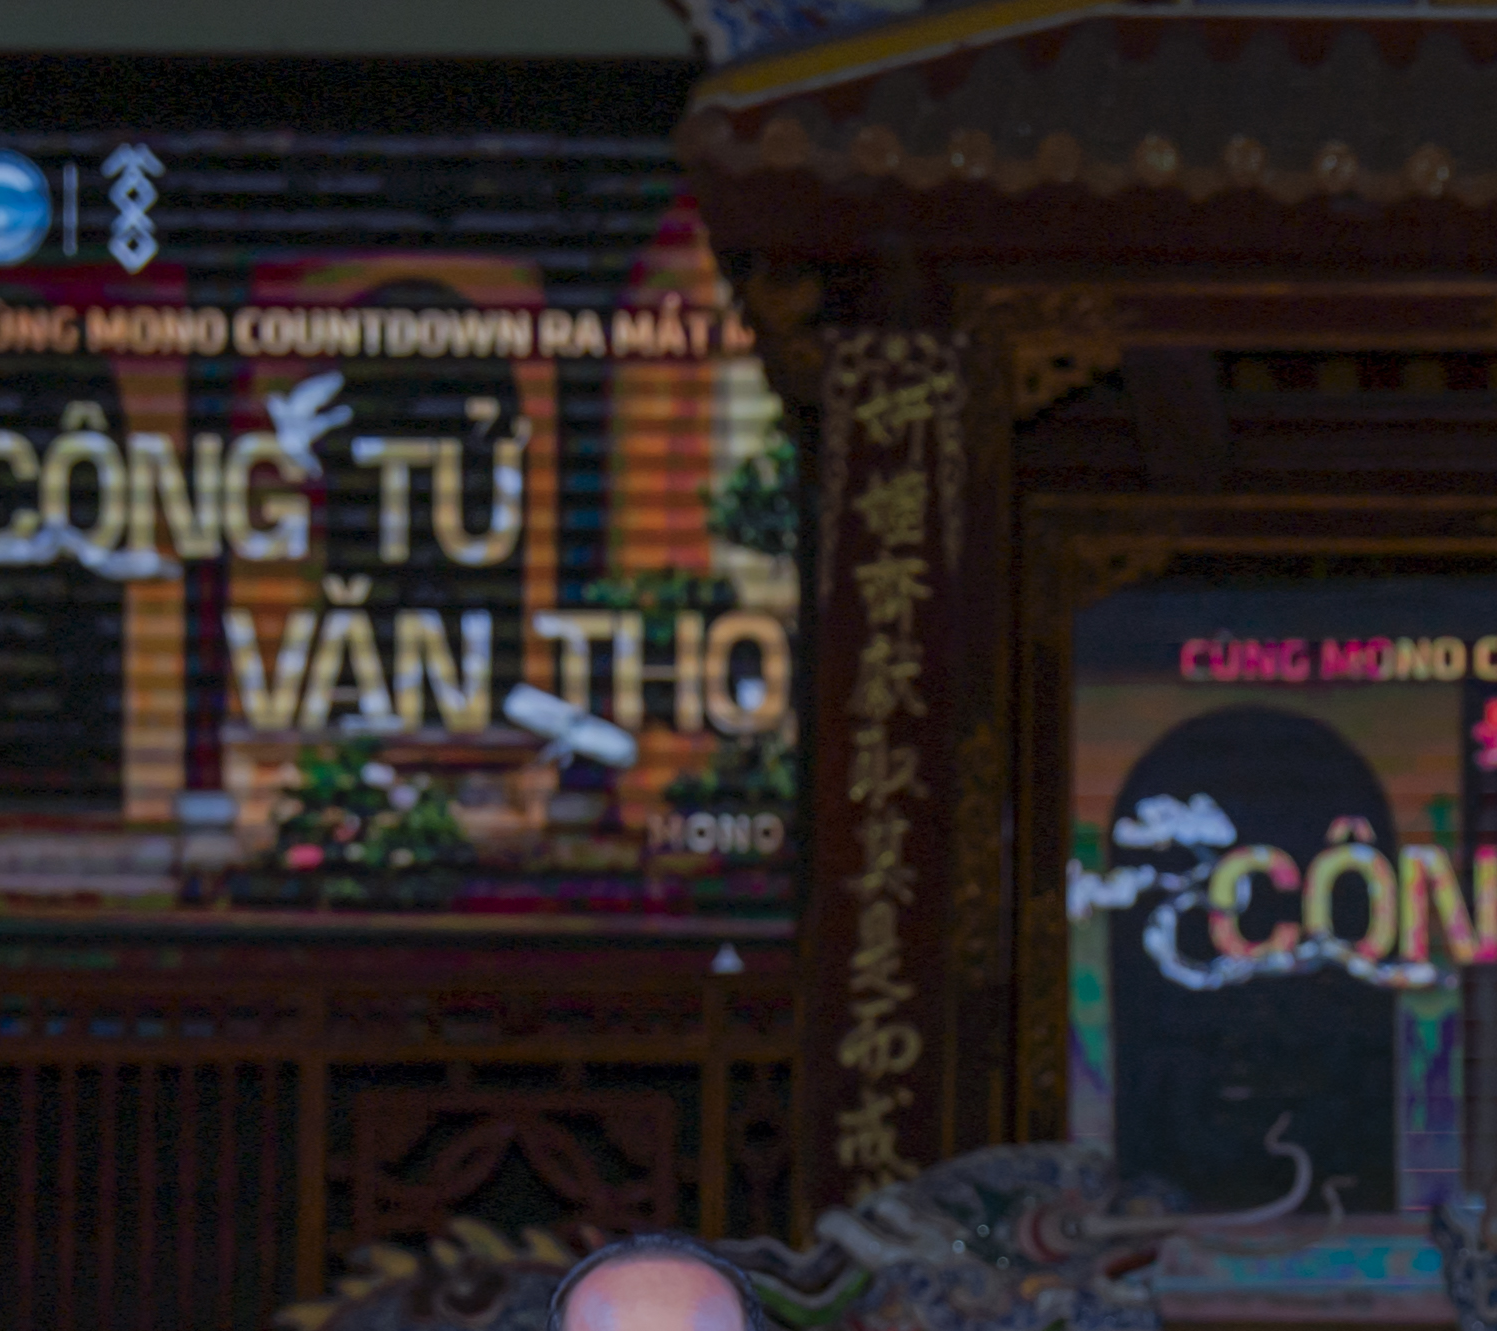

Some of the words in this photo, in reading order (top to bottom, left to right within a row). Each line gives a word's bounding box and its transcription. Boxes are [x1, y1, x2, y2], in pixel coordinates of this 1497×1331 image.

[85, 304, 229, 356] MONO
[232, 306, 536, 357] COUNTDOWN
[538, 307, 607, 358] RA
[352, 398, 531, 563] TỬ
[223, 573, 493, 733] VĂN
[1320, 635, 1467, 682] MONO
[648, 812, 784, 854] MONO
